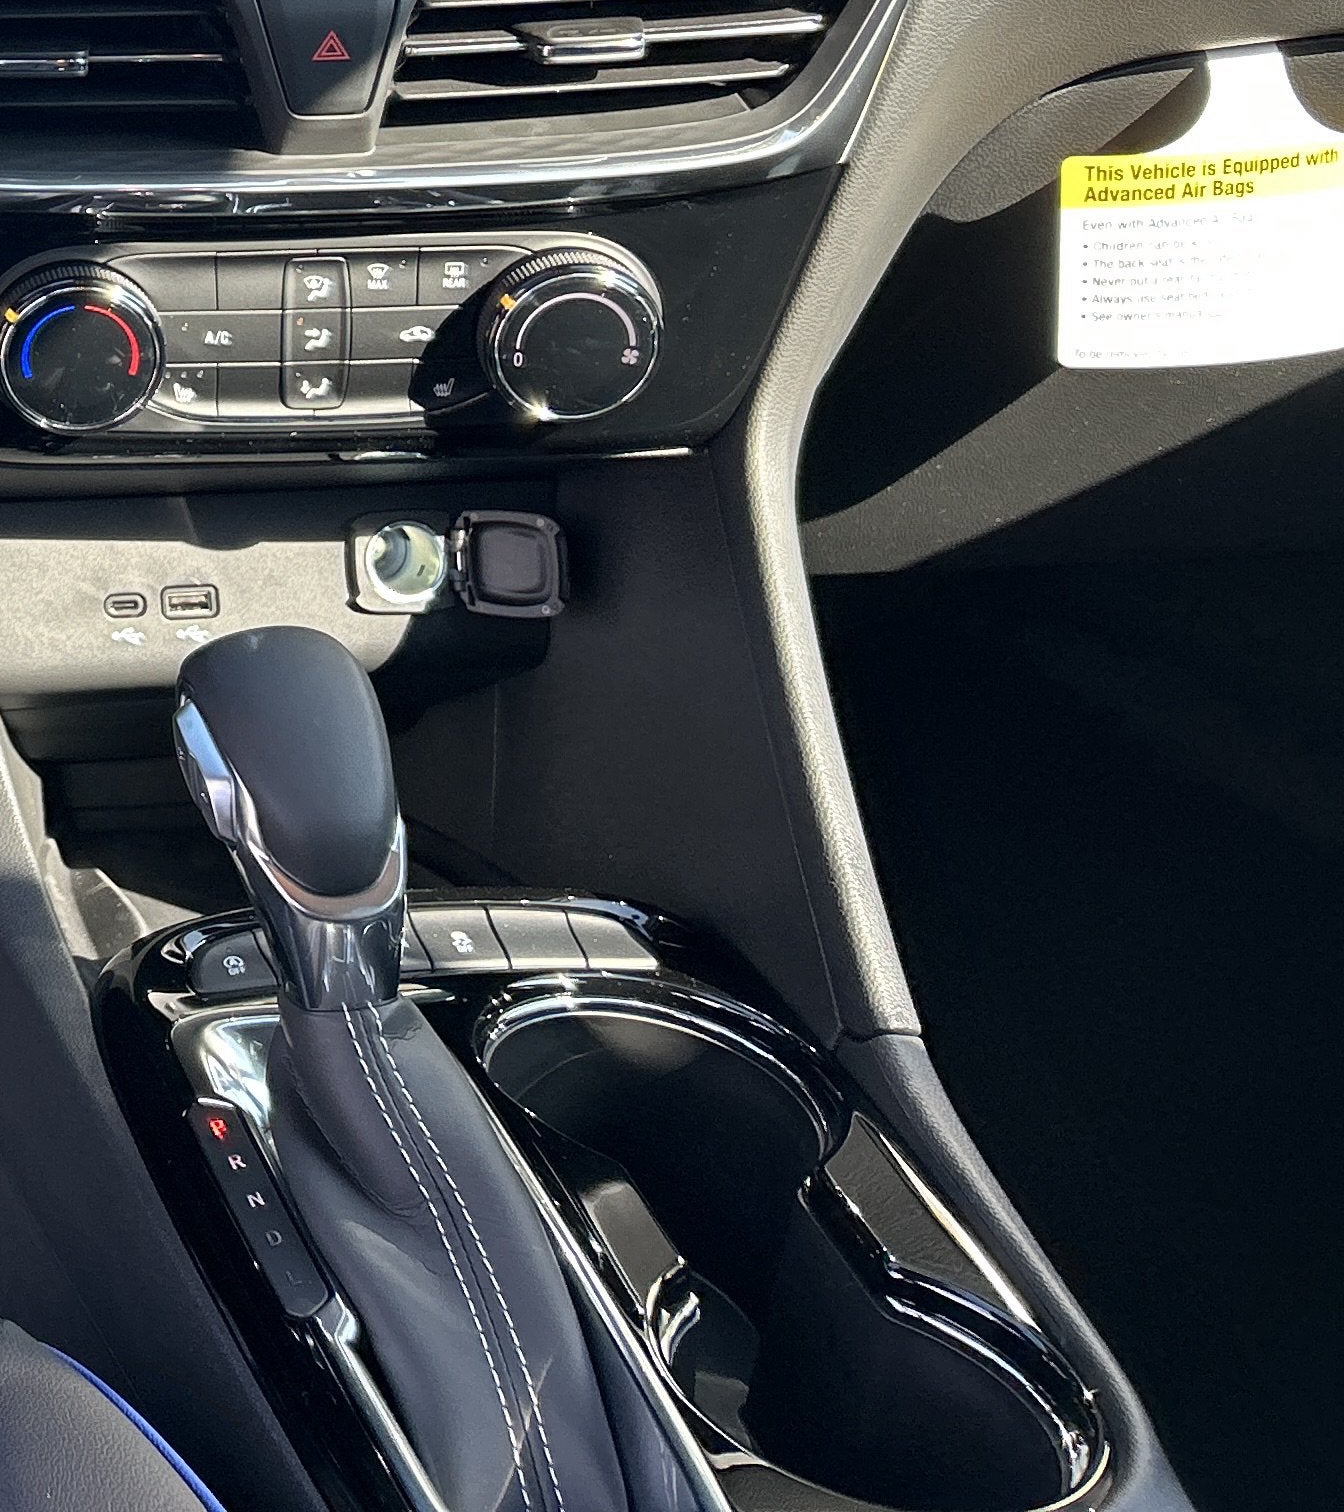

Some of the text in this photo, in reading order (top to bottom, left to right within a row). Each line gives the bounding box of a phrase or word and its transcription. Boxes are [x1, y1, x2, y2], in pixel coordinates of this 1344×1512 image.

[1084, 148, 1339, 182] This Vehicle is Equipped with
[1083, 180, 1255, 202] Advanced Air Bags
[204, 330, 233, 346] A/C
[513, 351, 524, 367] 0
[209, 1118, 227, 1139] P
[228, 1154, 247, 1170] R
[247, 1191, 266, 1208] N
[266, 1230, 282, 1247] D
